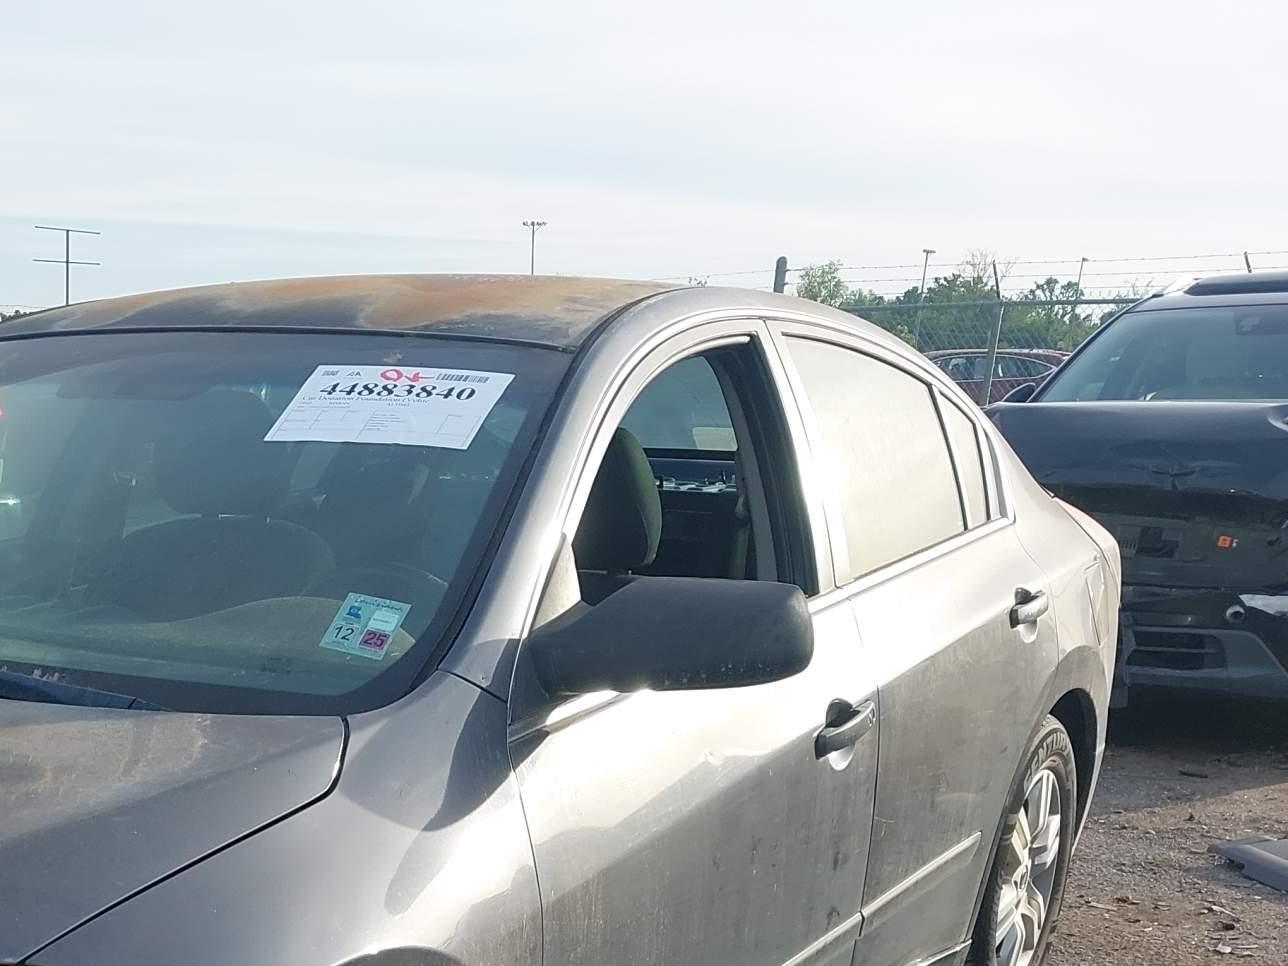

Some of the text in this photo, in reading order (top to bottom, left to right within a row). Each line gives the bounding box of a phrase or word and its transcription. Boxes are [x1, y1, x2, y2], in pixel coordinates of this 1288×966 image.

[319, 382, 477, 401] 44883840
[334, 625, 355, 641] 12
[363, 632, 388, 648] 25
